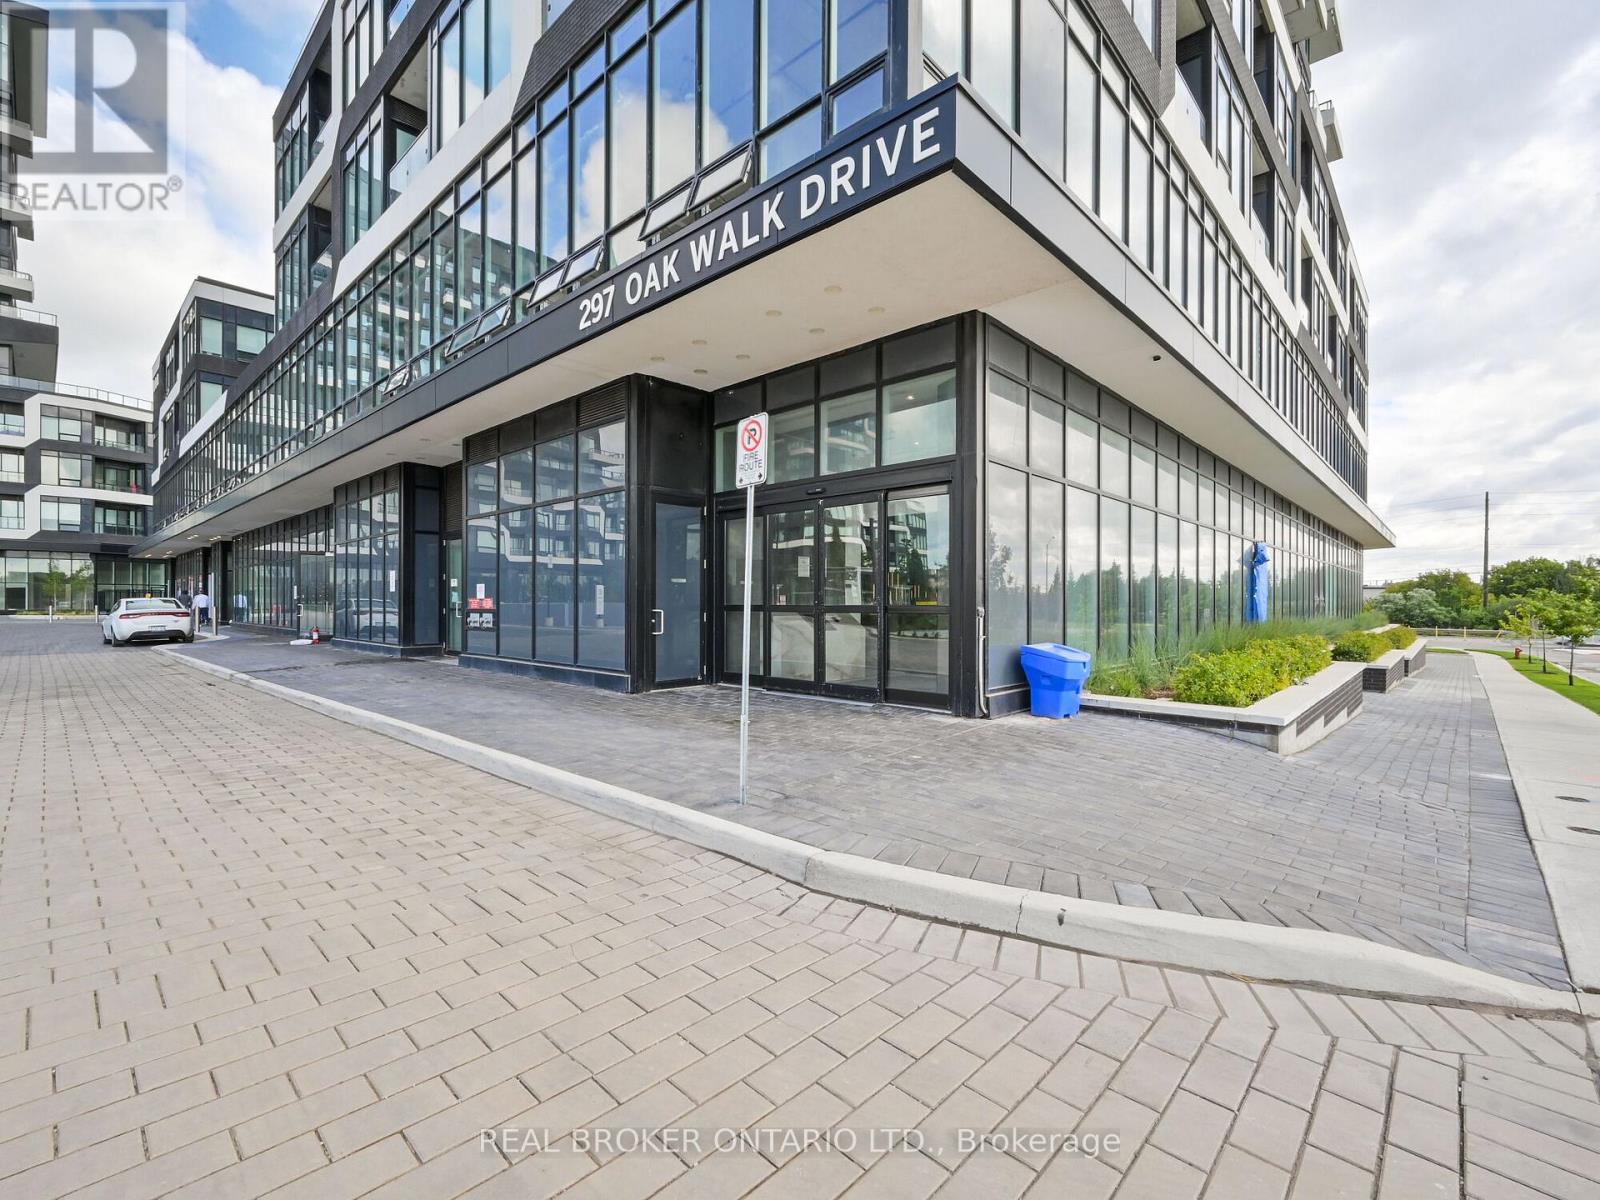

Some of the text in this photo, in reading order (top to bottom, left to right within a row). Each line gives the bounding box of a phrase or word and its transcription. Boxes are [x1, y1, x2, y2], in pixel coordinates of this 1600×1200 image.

[578, 106, 941, 331] 297 OAK WALK DRIVE
[739, 459, 763, 472] ROUTE
